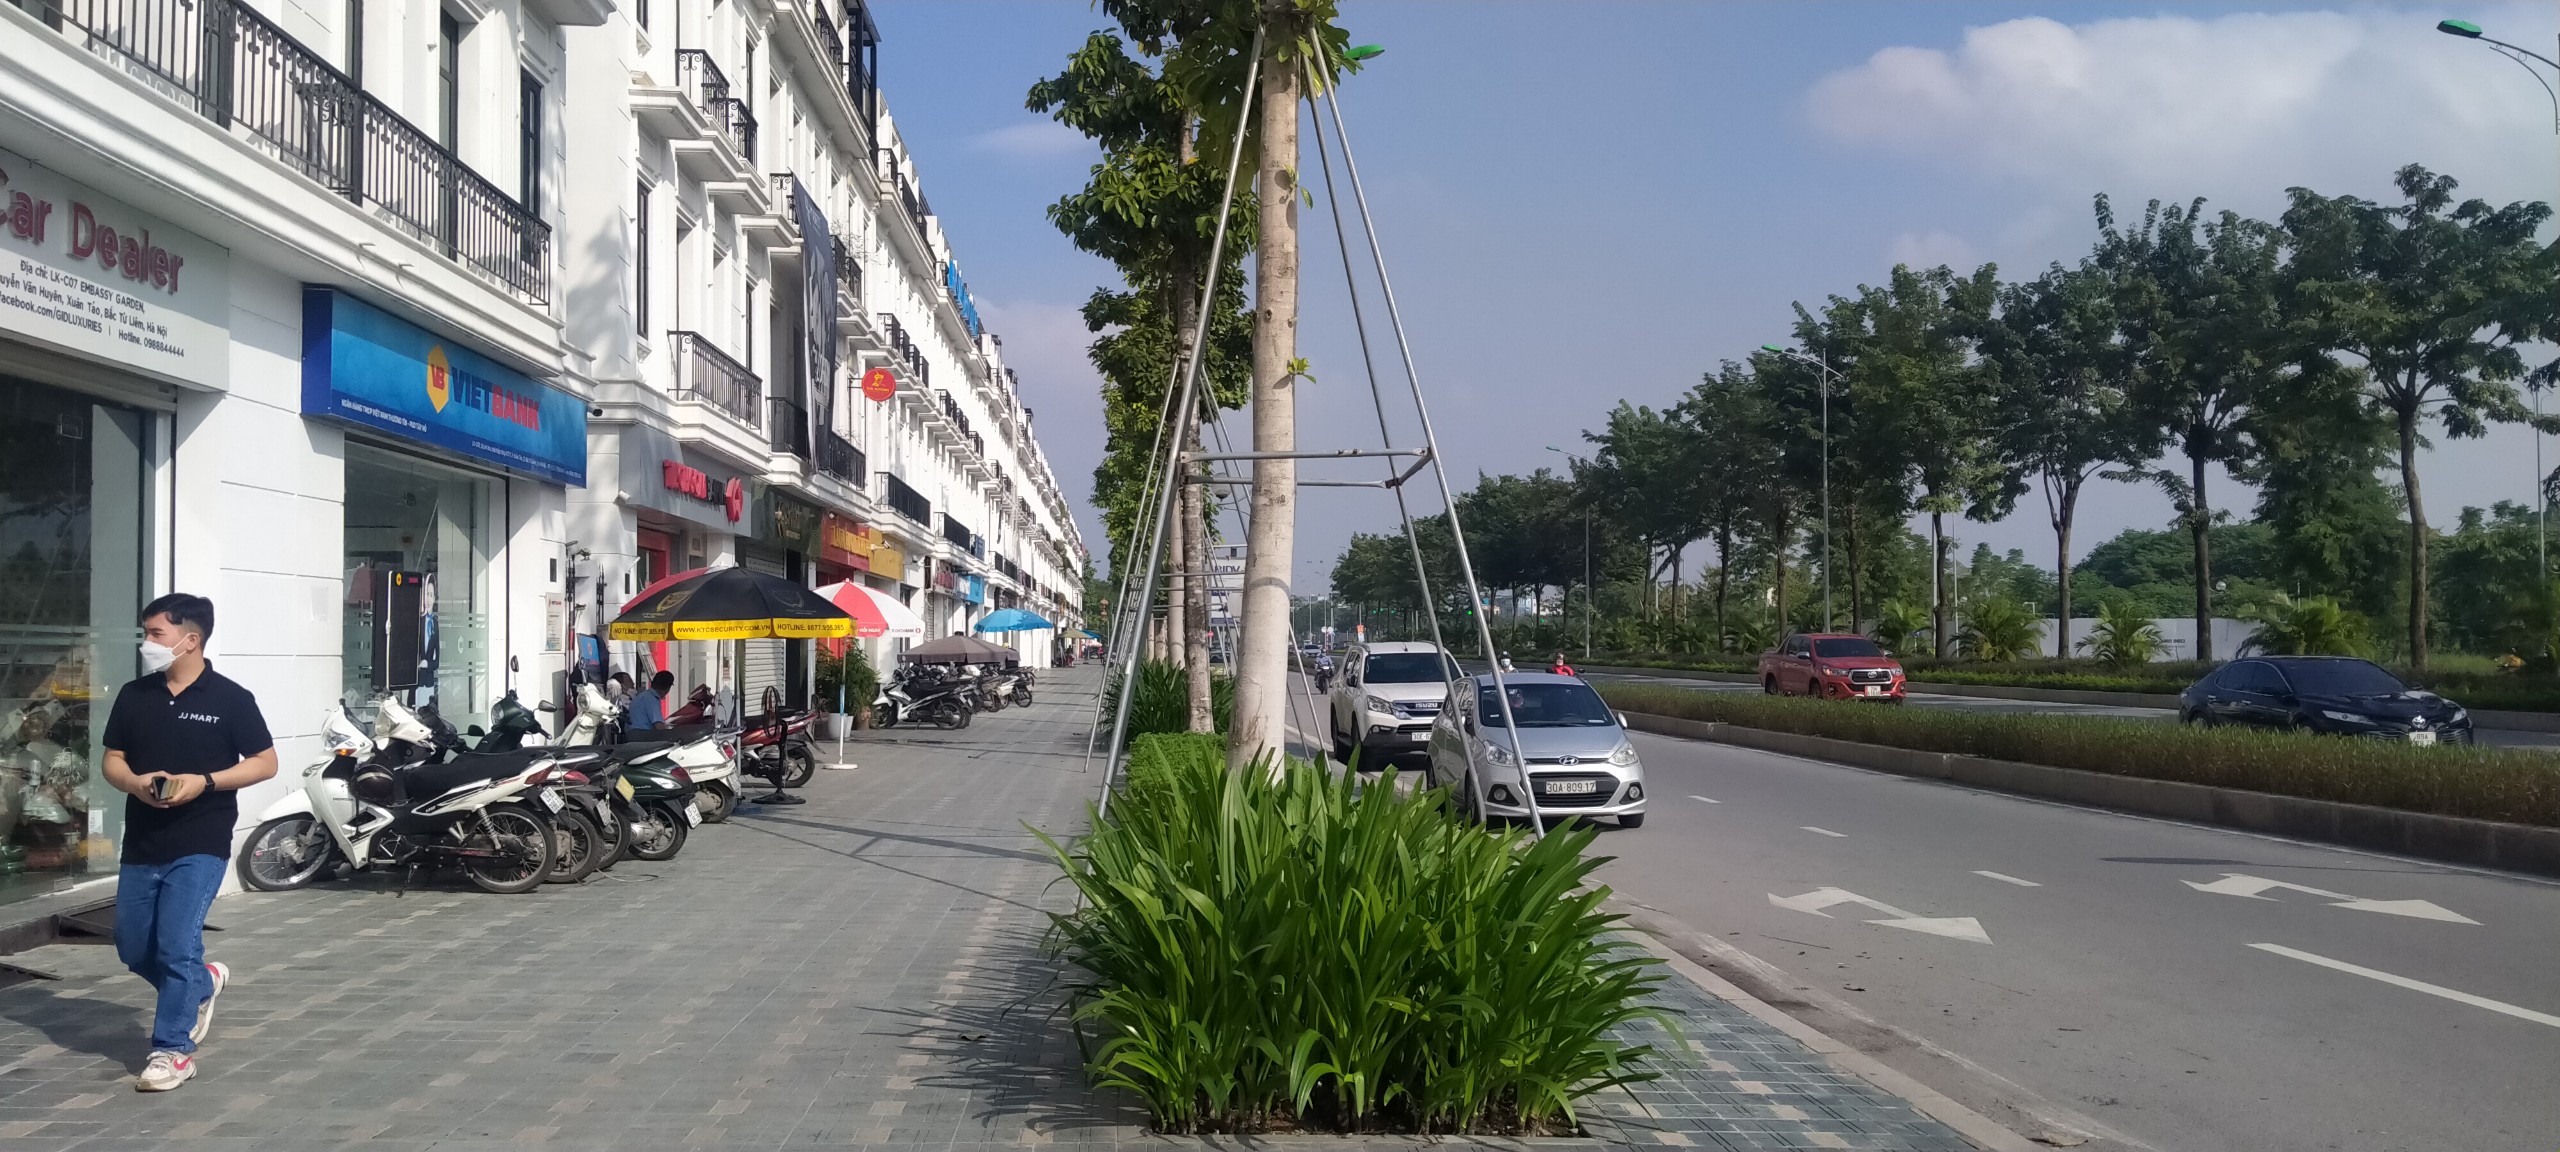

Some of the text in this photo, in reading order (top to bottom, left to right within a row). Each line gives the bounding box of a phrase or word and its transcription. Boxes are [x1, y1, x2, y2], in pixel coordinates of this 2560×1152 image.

[69, 202, 184, 294] Dealer
[20, 259, 33, 275] Địa
[50, 269, 78, 289] LK-C07
[80, 281, 114, 301] EMBASSY
[116, 293, 145, 314] GARDEN,
[23, 279, 37, 295] Văn
[39, 285, 64, 305] Huyên,
[67, 294, 84, 310] Xuân
[104, 306, 117, 321] Bắc
[119, 311, 128, 324] Từ
[129, 315, 146, 332] Liêm,
[147, 321, 155, 334] Hà
[157, 325, 168, 339] Nội
[451, 366, 540, 432] VIETBANK
[676, 624, 771, 633] WWW.KTCSECURITY.COM.VN
[178, 711, 220, 724] JJ MART
